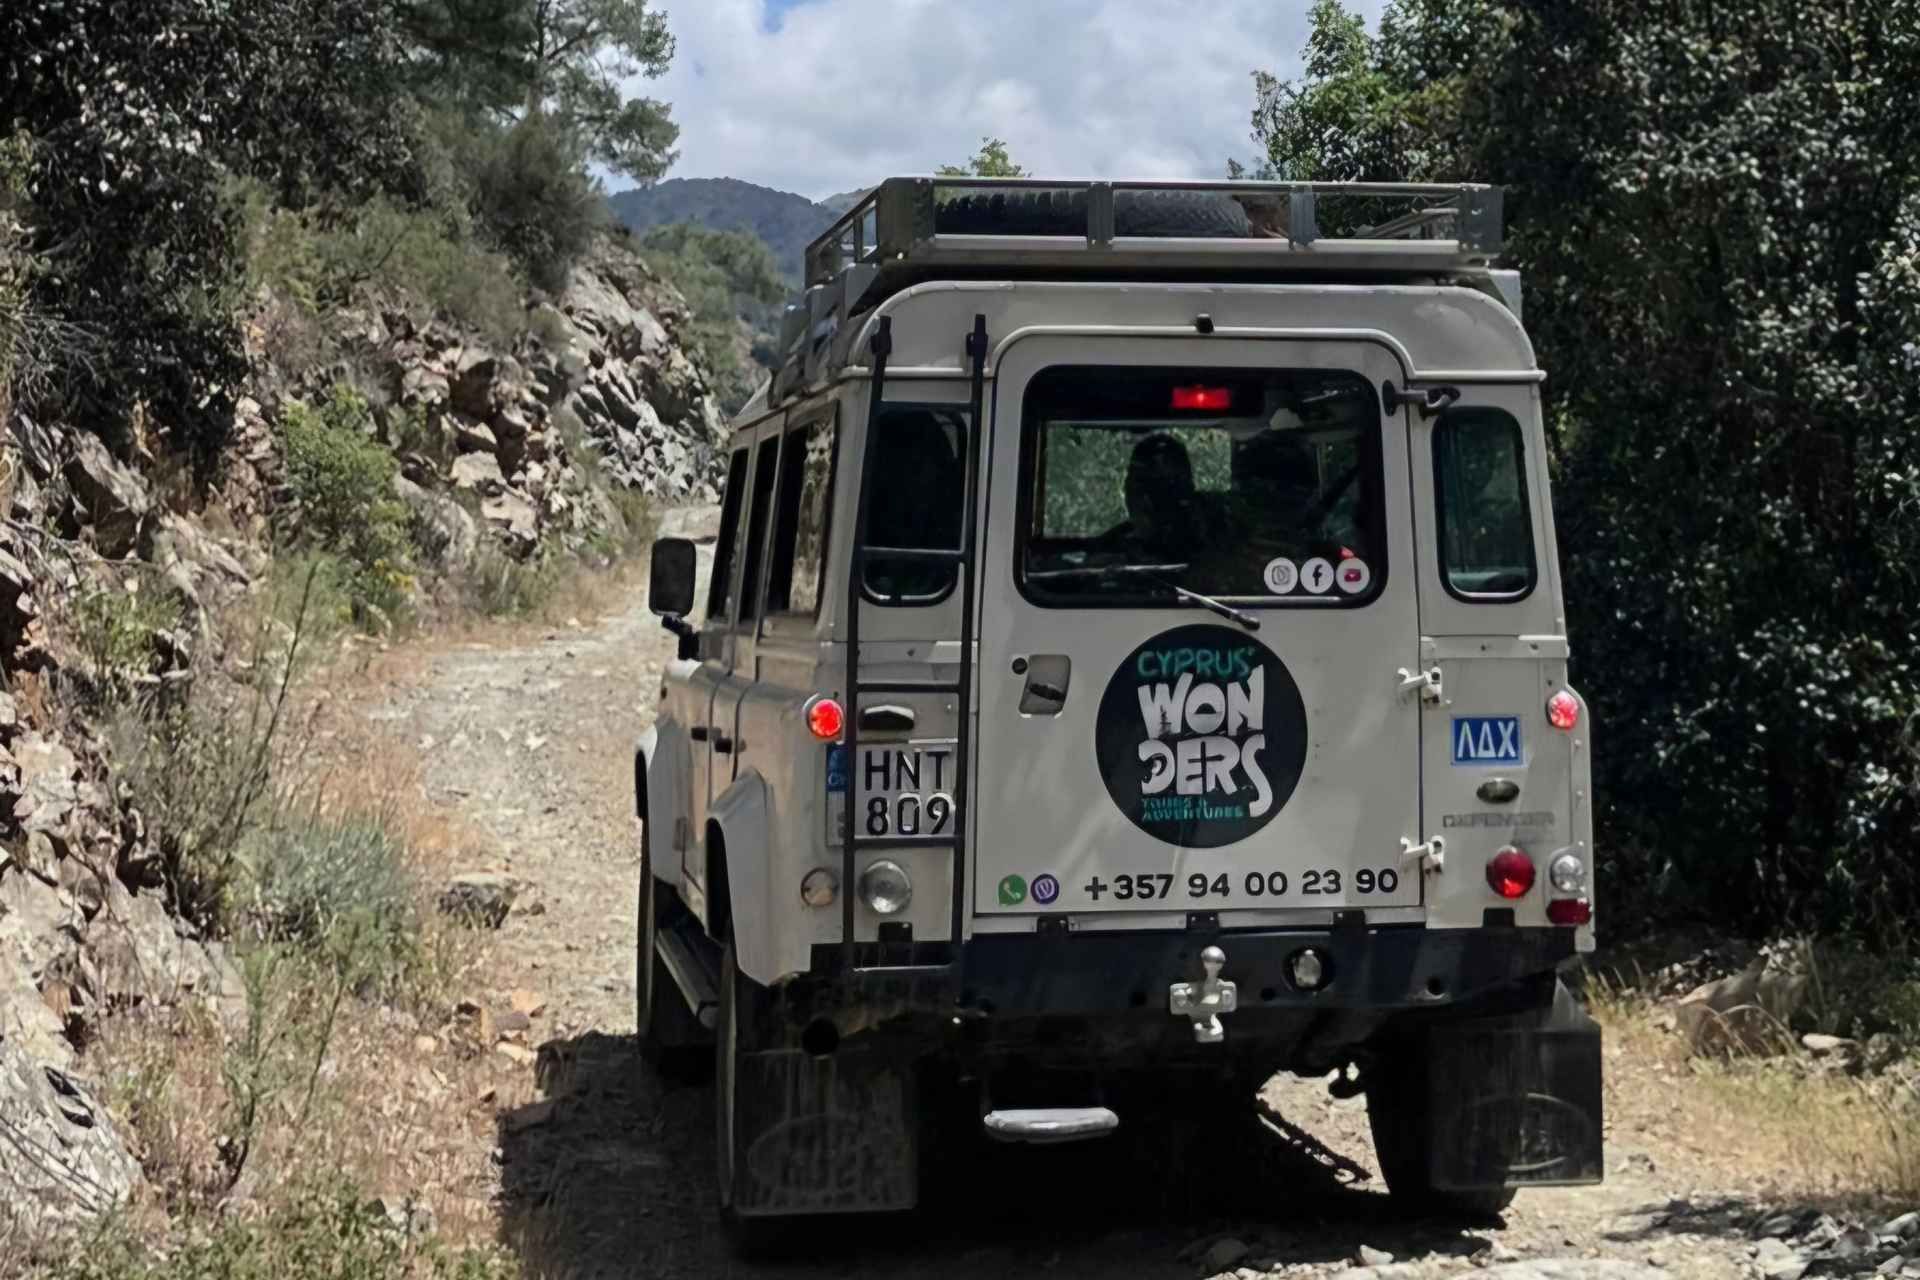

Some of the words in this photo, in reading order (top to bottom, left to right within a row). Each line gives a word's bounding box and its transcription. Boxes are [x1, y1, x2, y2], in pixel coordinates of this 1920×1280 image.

[1137, 663, 1265, 739] WON
[864, 750, 951, 791] HNT
[866, 796, 952, 836] 809
[1084, 874, 1174, 900] +357
[1188, 873, 1230, 898] 94
[1244, 872, 1288, 897] 00
[1301, 870, 1342, 895] 23
[1355, 868, 1399, 894] 90
